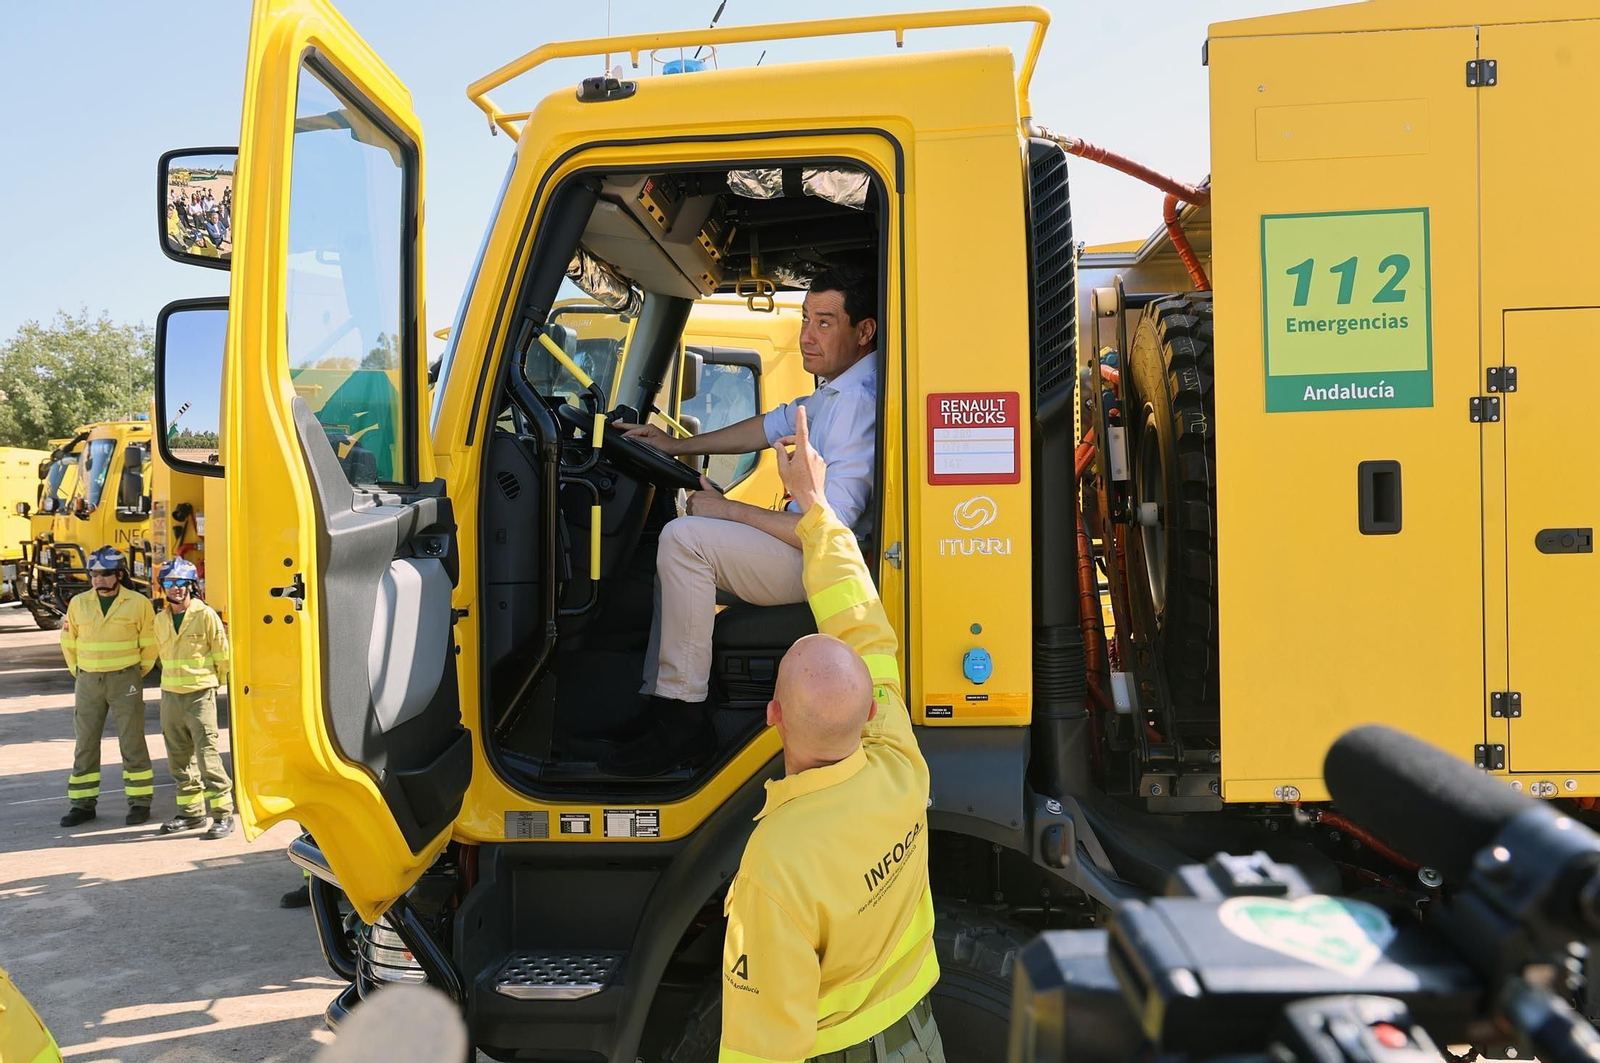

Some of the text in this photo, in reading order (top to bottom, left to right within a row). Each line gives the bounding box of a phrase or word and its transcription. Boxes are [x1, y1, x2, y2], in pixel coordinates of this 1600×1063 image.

[1286, 254, 1411, 306] 112
[1286, 312, 1409, 336] Emergencias
[1303, 380, 1395, 401] Andalucía
[940, 399, 1006, 412] RENAULT
[941, 411, 1006, 425] TRUCKS
[940, 537, 1012, 556] ITURRI
[863, 822, 920, 892] INFOCA
[733, 983, 760, 994] Andalucía
